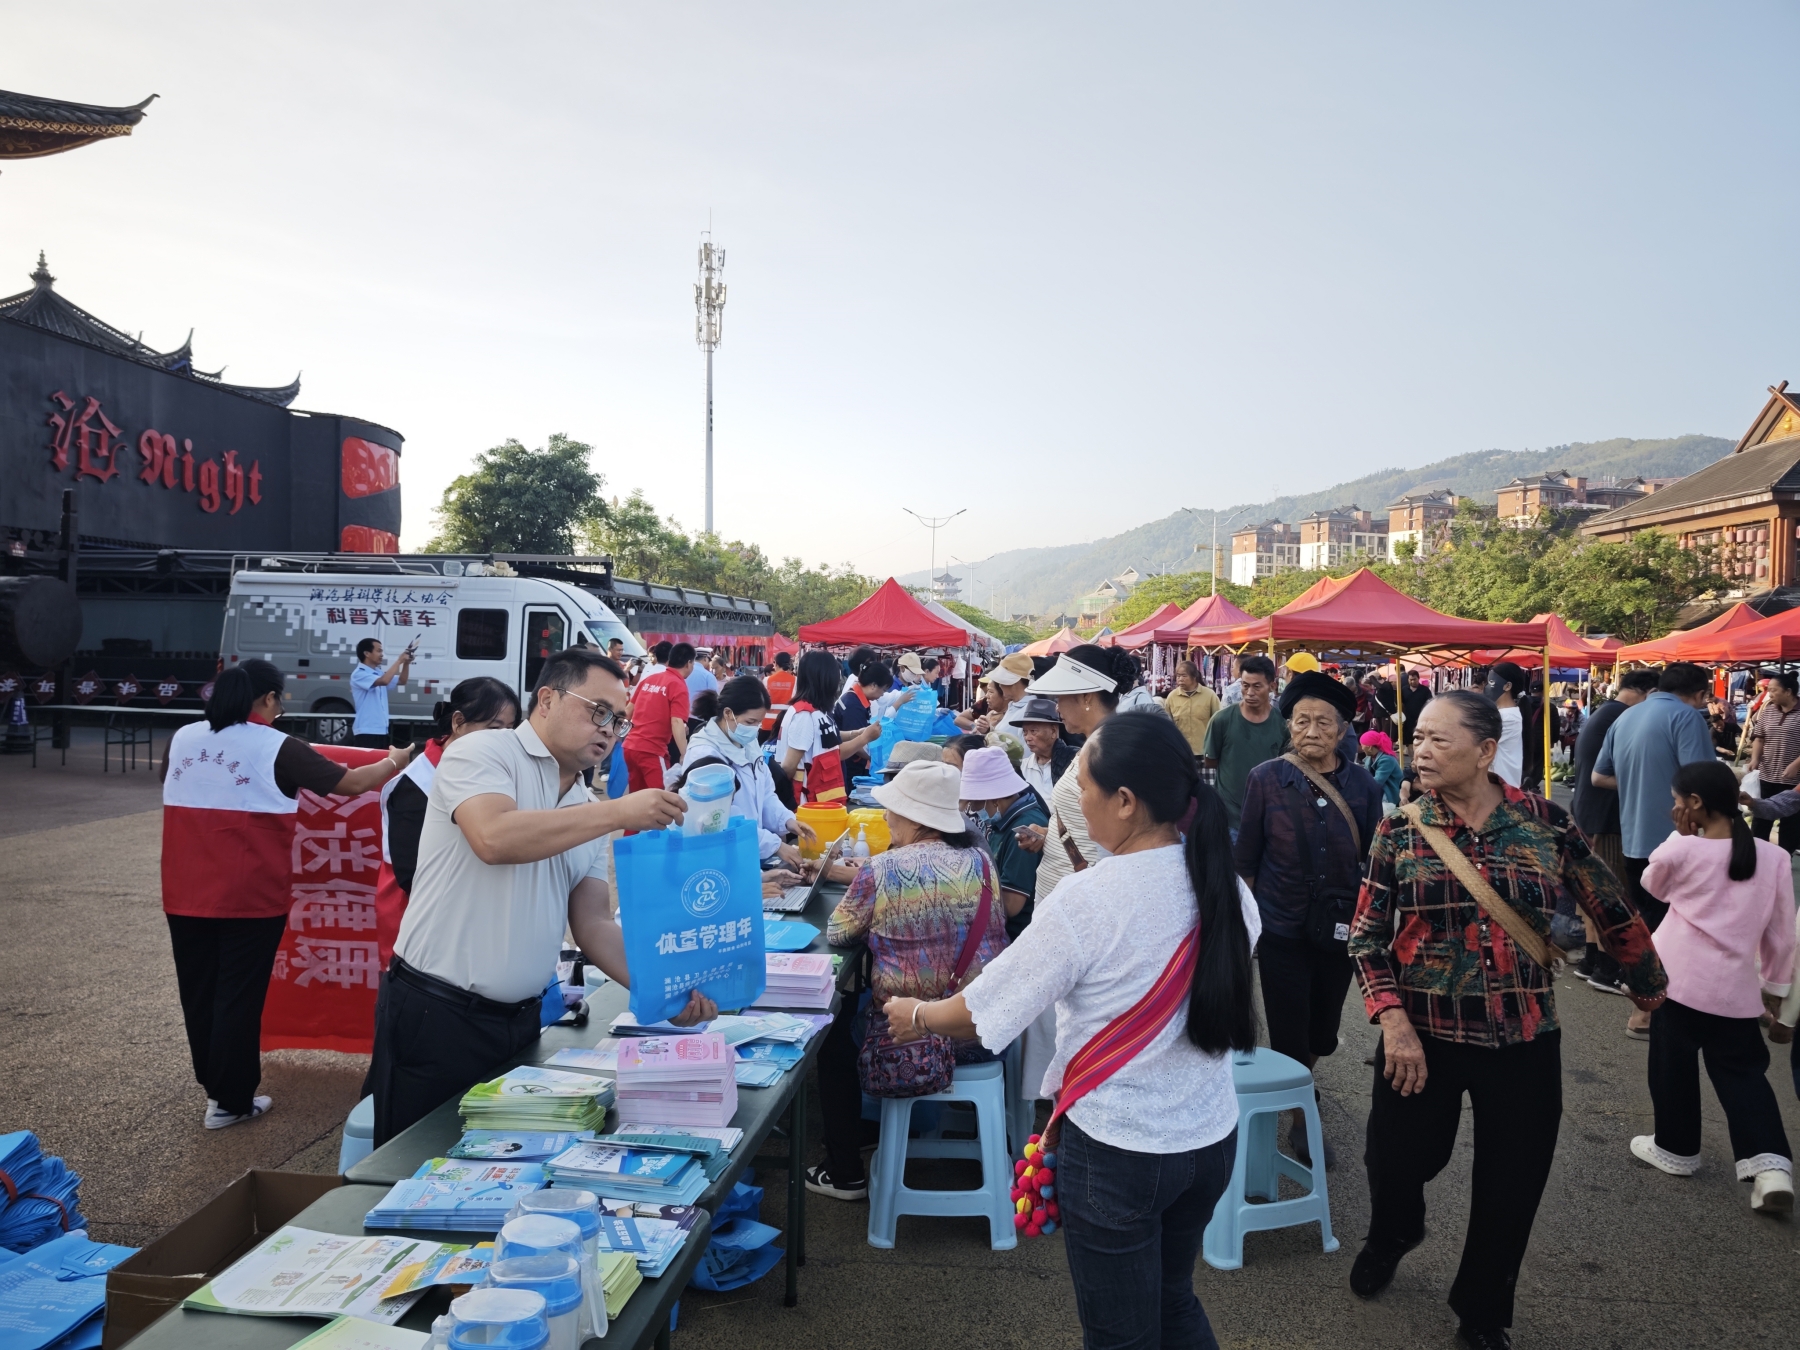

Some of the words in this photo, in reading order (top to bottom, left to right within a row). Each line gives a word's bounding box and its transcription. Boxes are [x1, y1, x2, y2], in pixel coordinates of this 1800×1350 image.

[46, 390, 128, 483] 沧
[139, 428, 263, 515] Night
[309, 587, 454, 606] 澜沧县科学技术协会
[326, 607, 437, 627] 科普大篷车
[172, 748, 251, 787] 澜沧县志愿者
[655, 916, 752, 956] 体重管理年
